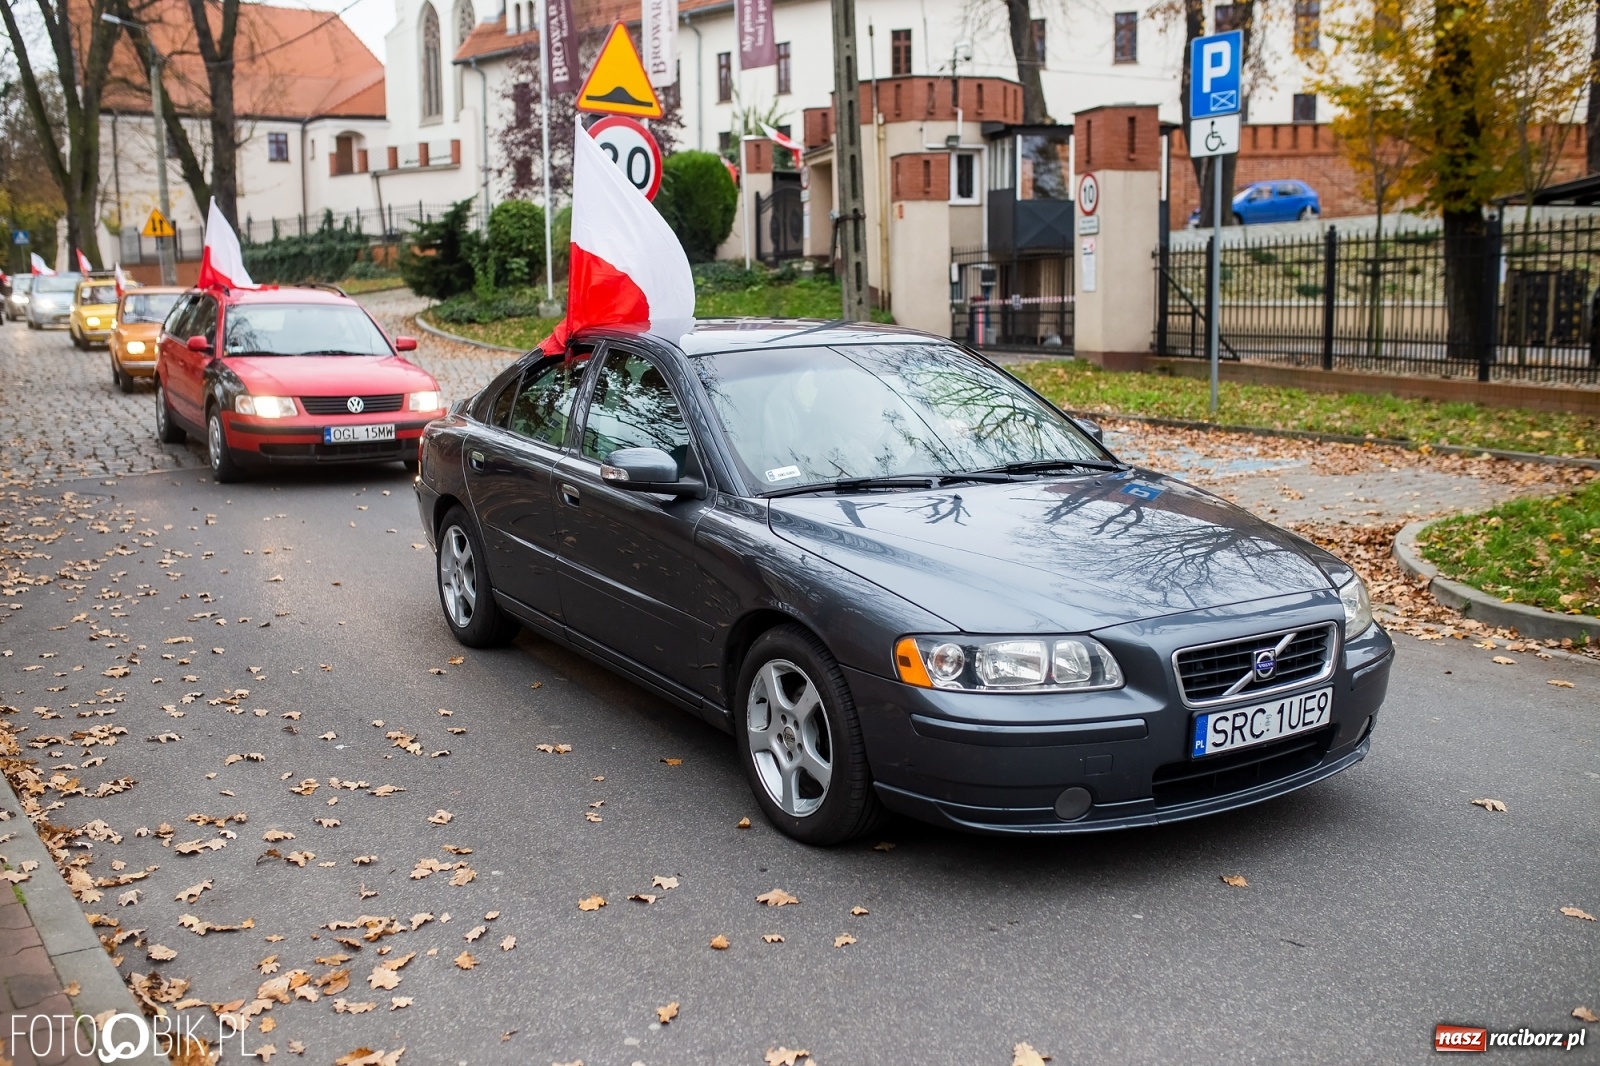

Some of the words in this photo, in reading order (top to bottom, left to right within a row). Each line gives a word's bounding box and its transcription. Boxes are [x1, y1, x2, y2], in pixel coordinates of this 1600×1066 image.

[548, 3, 570, 84] BROWAR
[651, 0, 666, 75] BROWAR
[1202, 40, 1231, 93] P
[1083, 185, 1095, 204] 10
[333, 427, 359, 441] OGL
[365, 425, 394, 440] 15MW
[1257, 661, 1275, 669] VOLVO
[1195, 740, 1205, 750] PL
[1211, 707, 1267, 747] SRC
[1277, 691, 1328, 734] 1UE9
